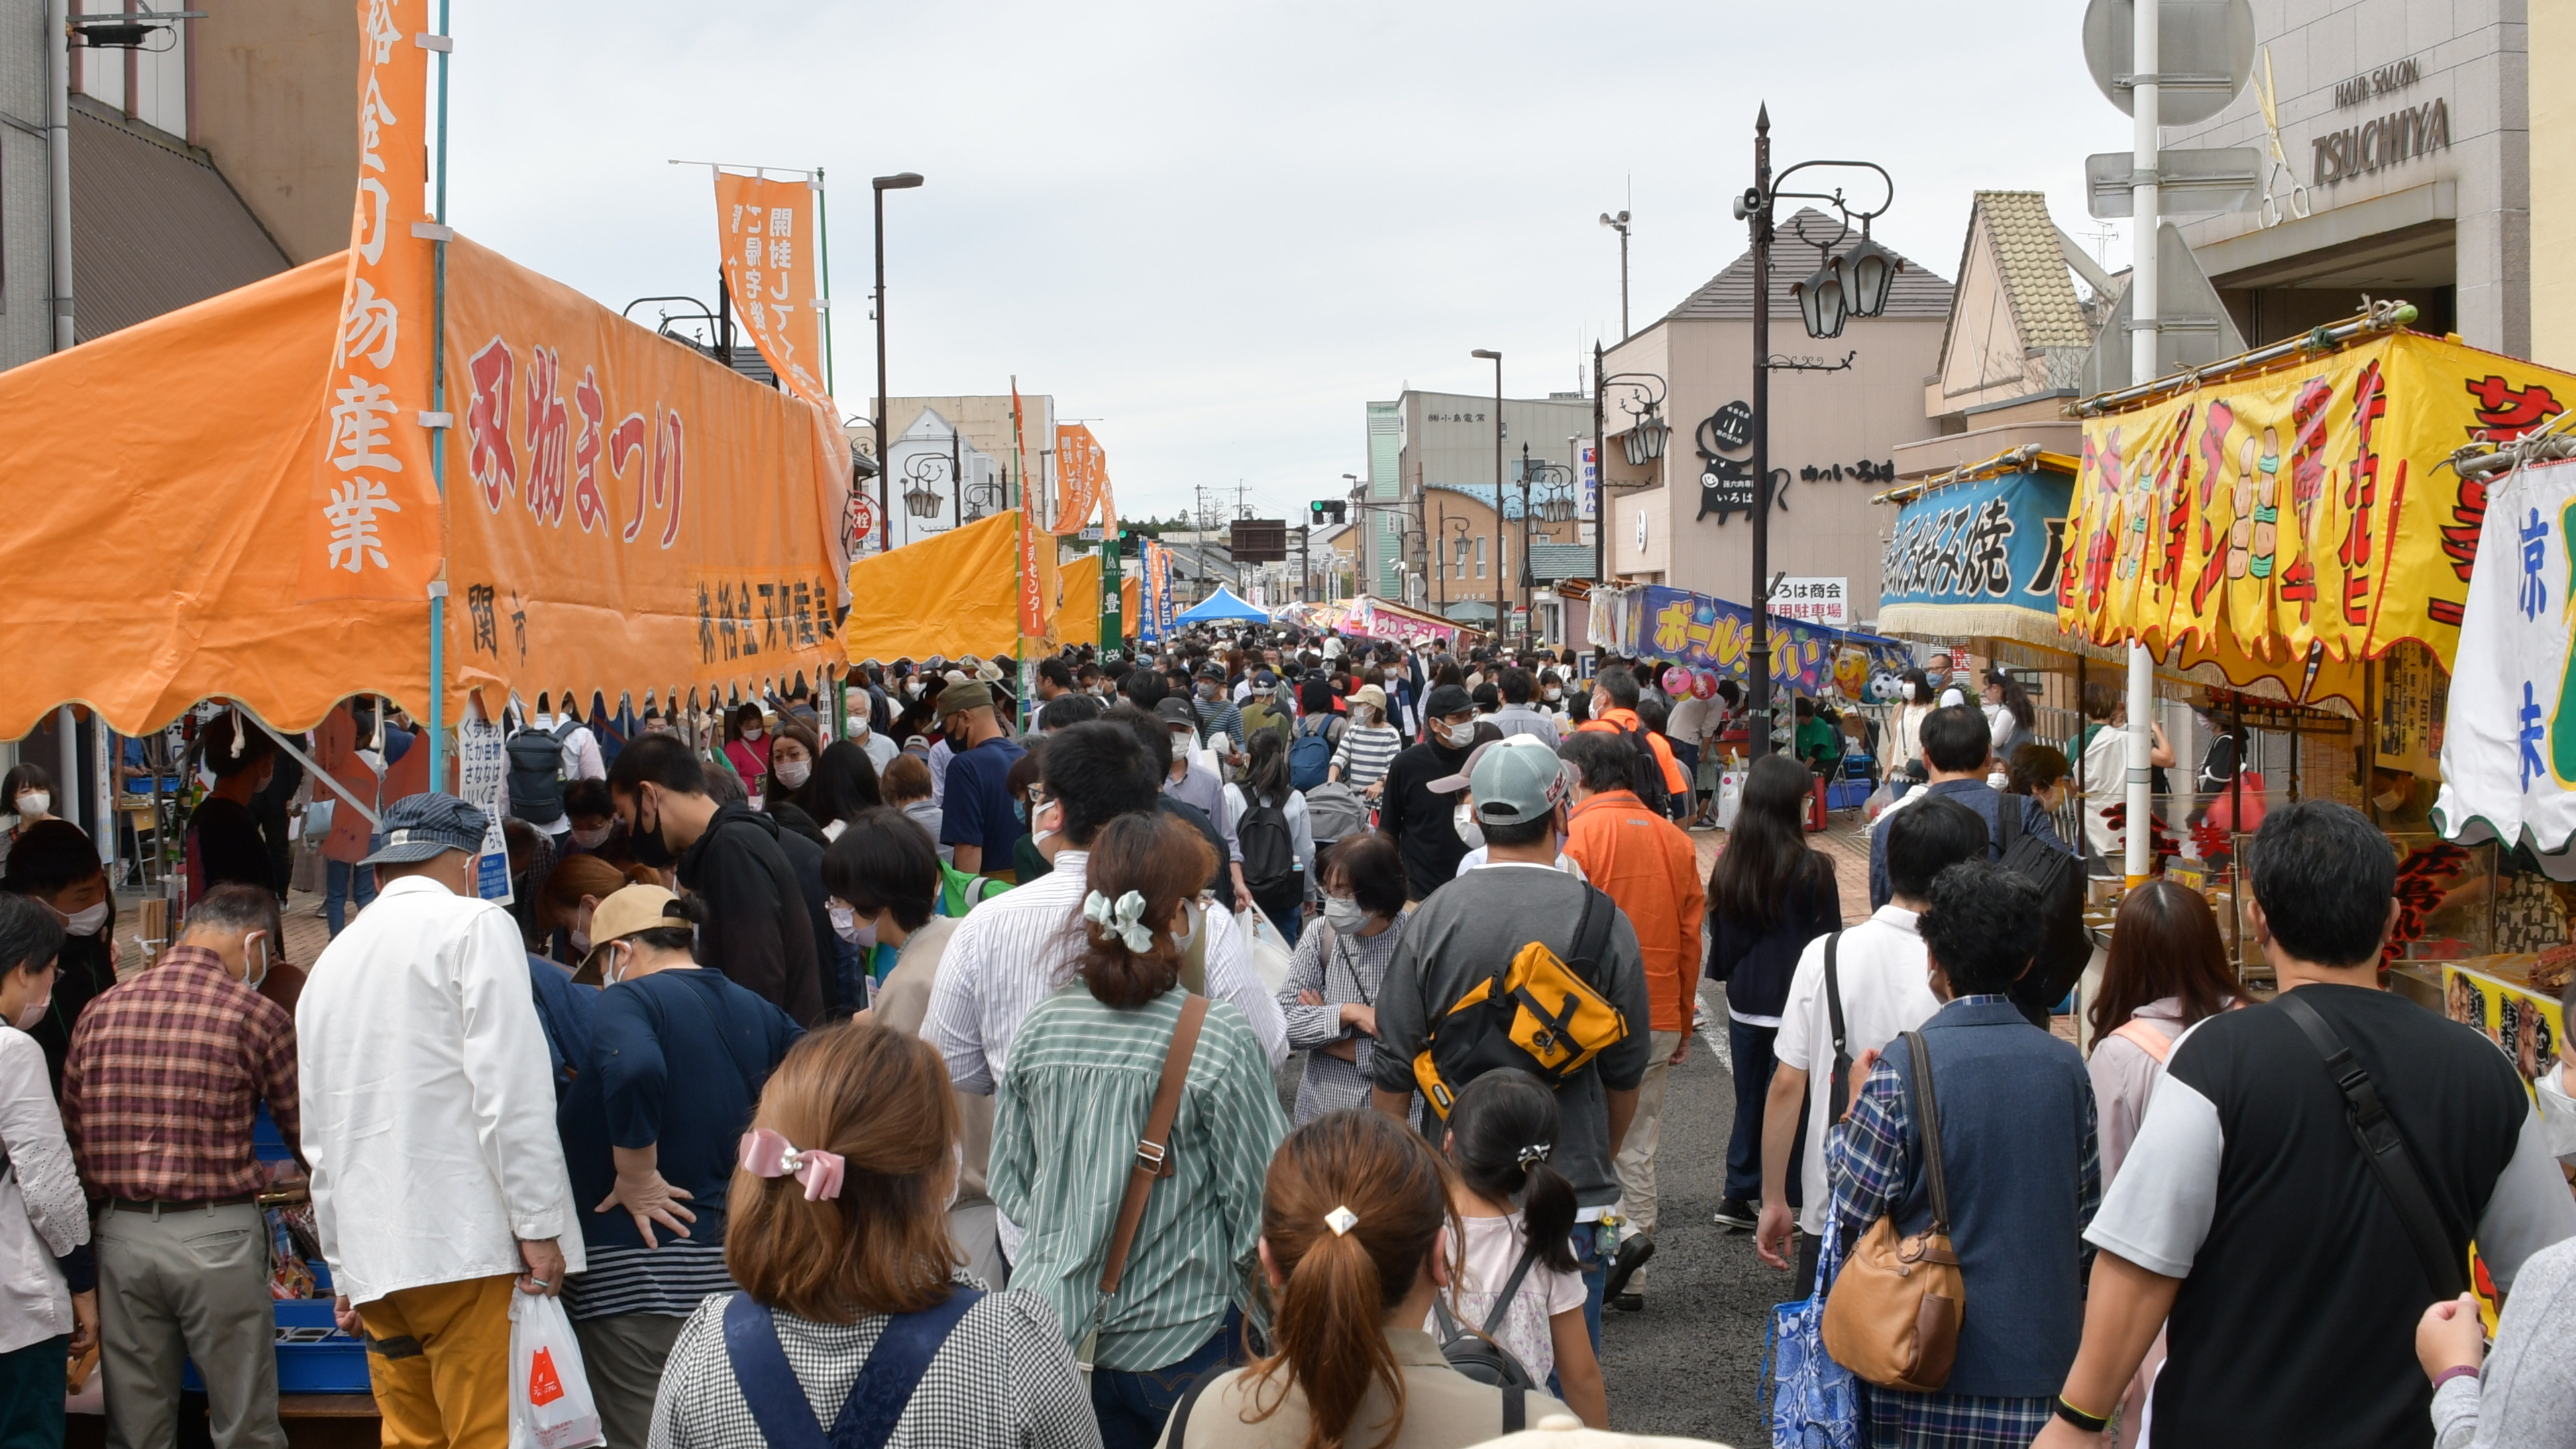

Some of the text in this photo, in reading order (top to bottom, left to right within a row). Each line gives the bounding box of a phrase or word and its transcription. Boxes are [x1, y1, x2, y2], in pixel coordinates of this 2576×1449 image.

[2334, 58, 2418, 108] HAIR SALON
[2312, 97, 2448, 185] TSUCHIYA
[468, 334, 684, 550] 刃物まつり
[1717, 492, 1753, 503] いろは
[1723, 480, 1754, 488] 孫六肉専
[1774, 583, 1841, 598] ろは商会
